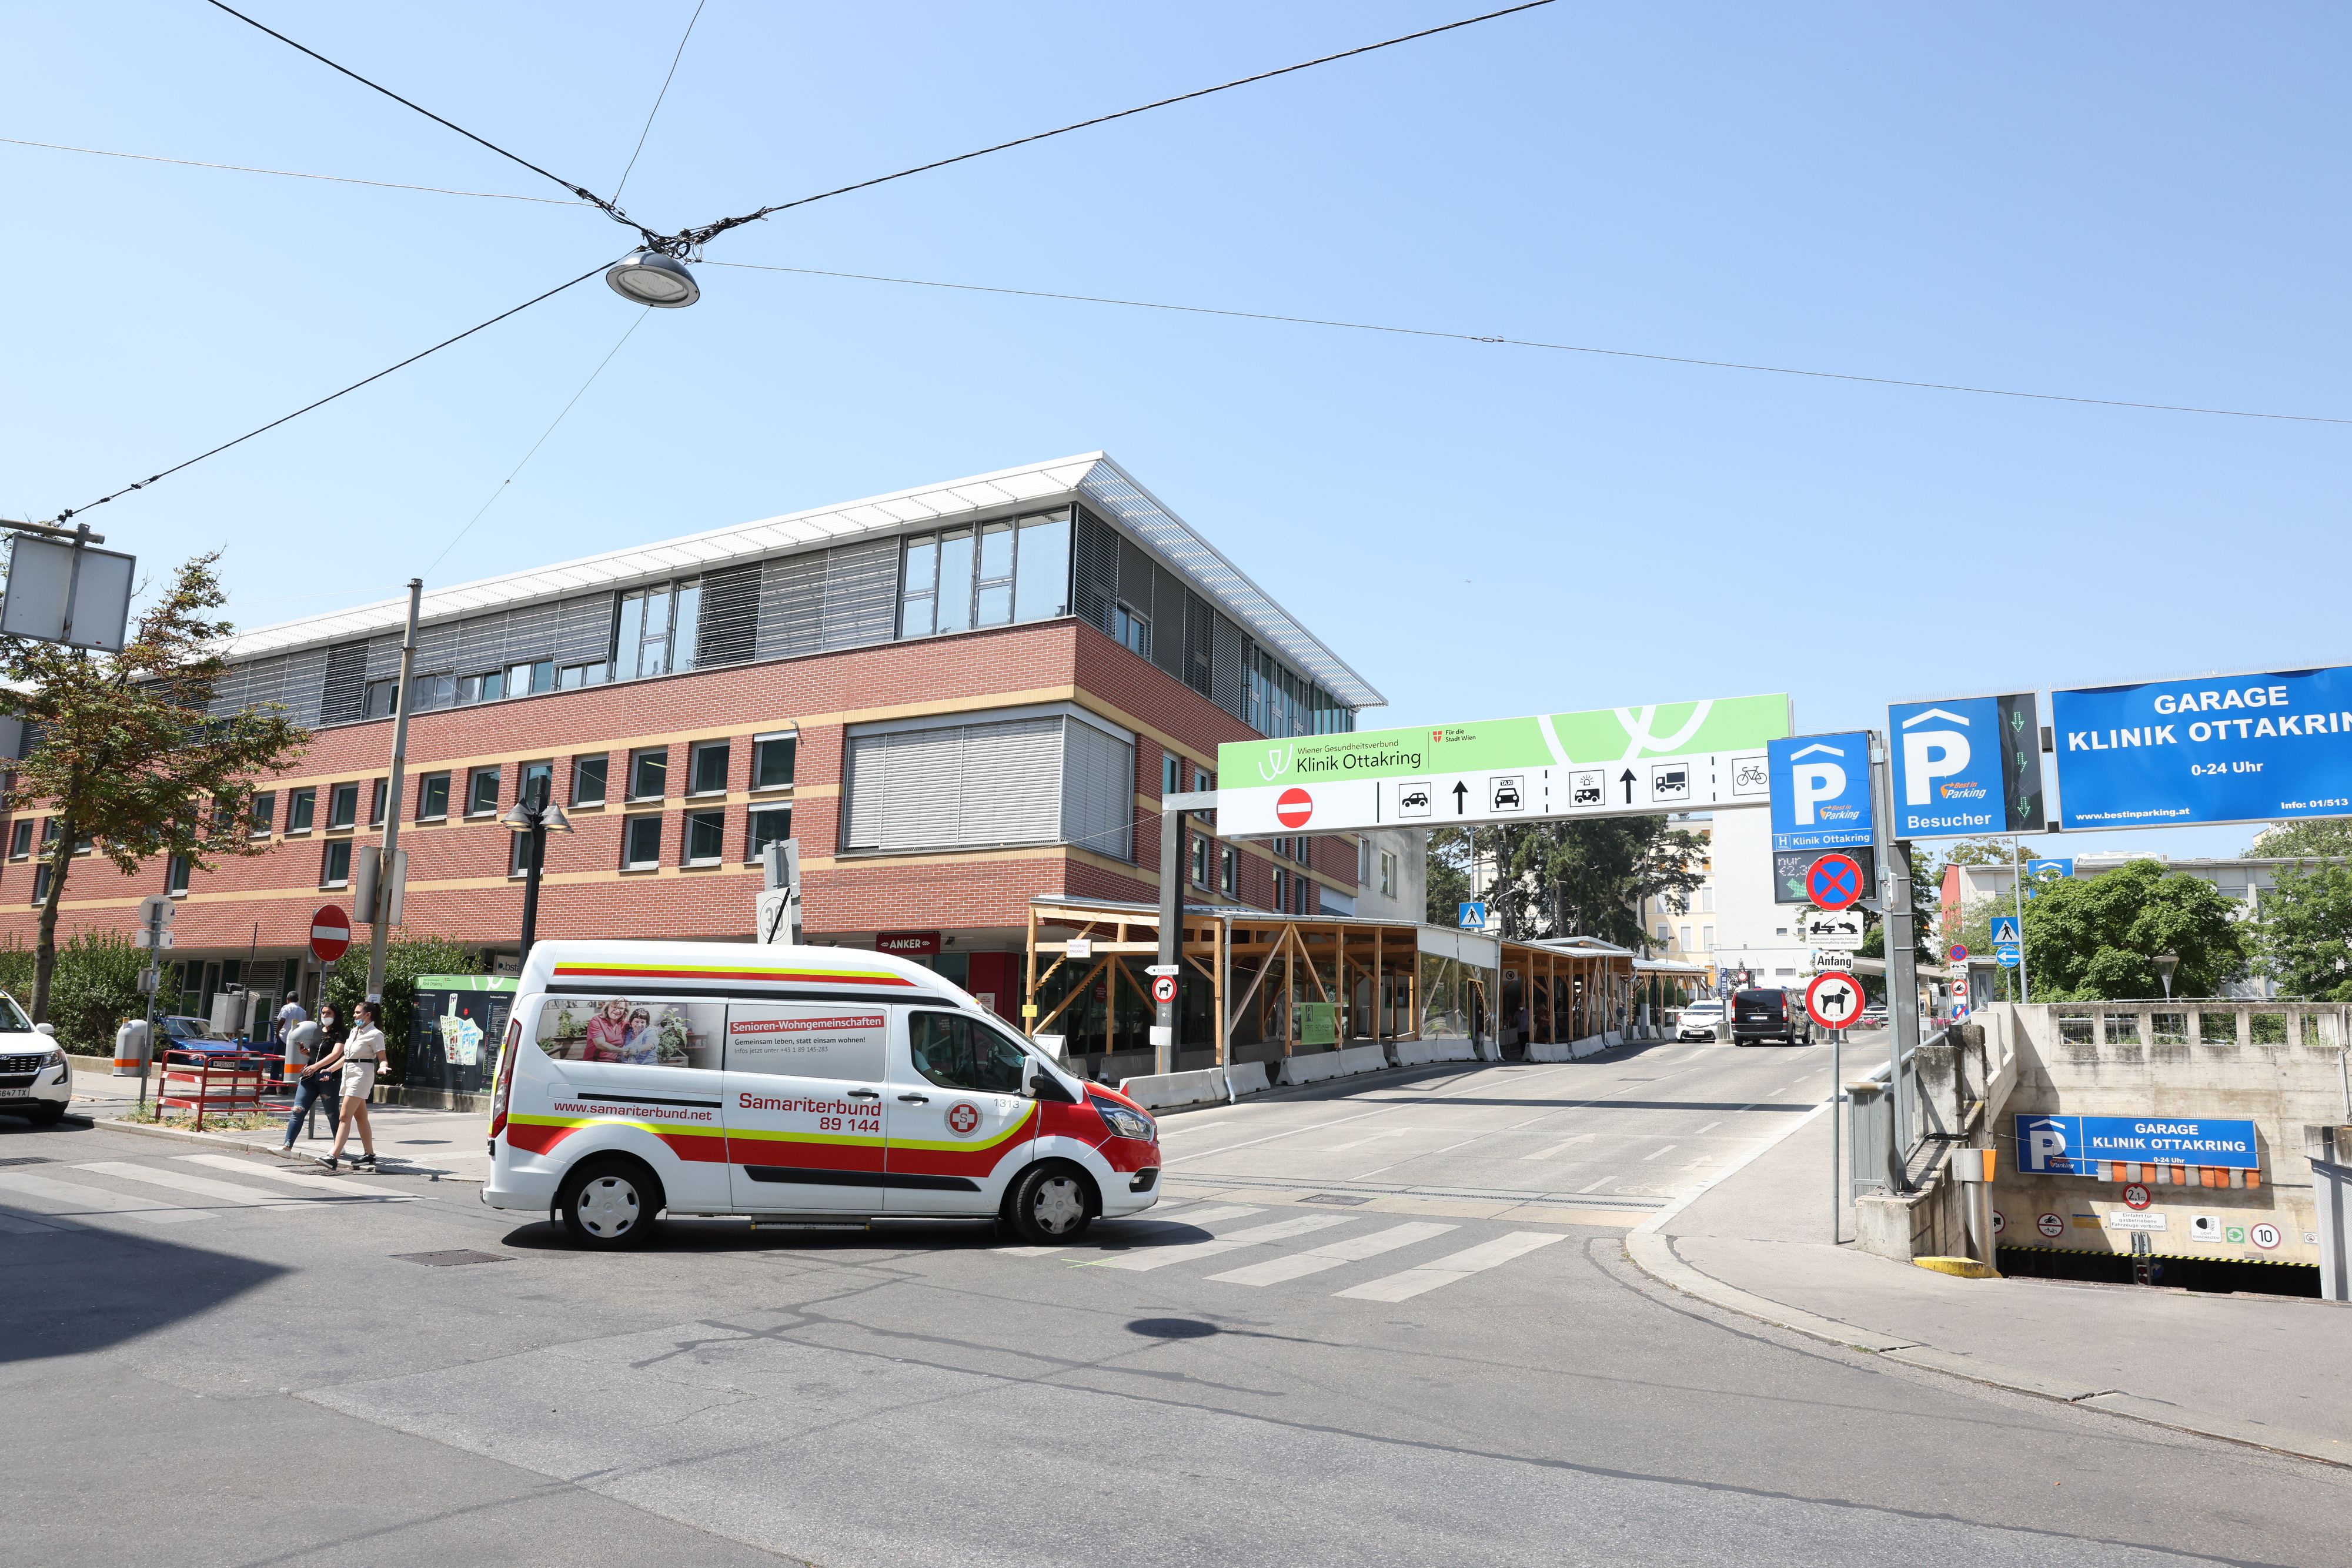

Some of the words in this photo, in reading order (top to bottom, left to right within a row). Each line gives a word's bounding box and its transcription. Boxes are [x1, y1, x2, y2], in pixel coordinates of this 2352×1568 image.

[2154, 686, 2288, 714] GARAGE
[2068, 724, 2177, 751] KLINIK
[1298, 746, 1323, 754] Wiener
[1324, 739, 1399, 753] Gesundheitsverbund
[1297, 755, 1339, 773] Klinik
[1343, 751, 1421, 768] Ottakring
[2191, 763, 2227, 775] 0-24
[2233, 761, 2263, 773] Uhr
[1946, 788, 1987, 799] Parking
[2309, 798, 2348, 808] 01/513
[1824, 810, 1860, 820] Parking
[1907, 813, 1992, 829] Besucher
[2076, 807, 2190, 821] www.bestinparking.at
[1779, 836, 1788, 845] H
[1793, 836, 1820, 845] Klinik
[1823, 834, 1870, 844] Ottakring
[1778, 857, 1801, 865] nur
[765, 905, 783, 934] 30
[889, 939, 921, 949] ANKER
[1817, 955, 1852, 968] Anfang
[733, 1017, 881, 1032] Senioren-Wohngemeinschaften
[739, 1092, 881, 1116] Samariterbund
[994, 1098, 1020, 1109] 1313
[554, 1102, 712, 1121] www.samariterbund.net
[960, 1113, 968, 1123] S
[820, 1117, 841, 1131] 89
[848, 1118, 880, 1133] 144
[2135, 1123, 2199, 1135] GARAGE
[2093, 1136, 2146, 1149] KLINIK
[2151, 1138, 2246, 1152] OTTAKRING
[2259, 1229, 2273, 1243] 10
